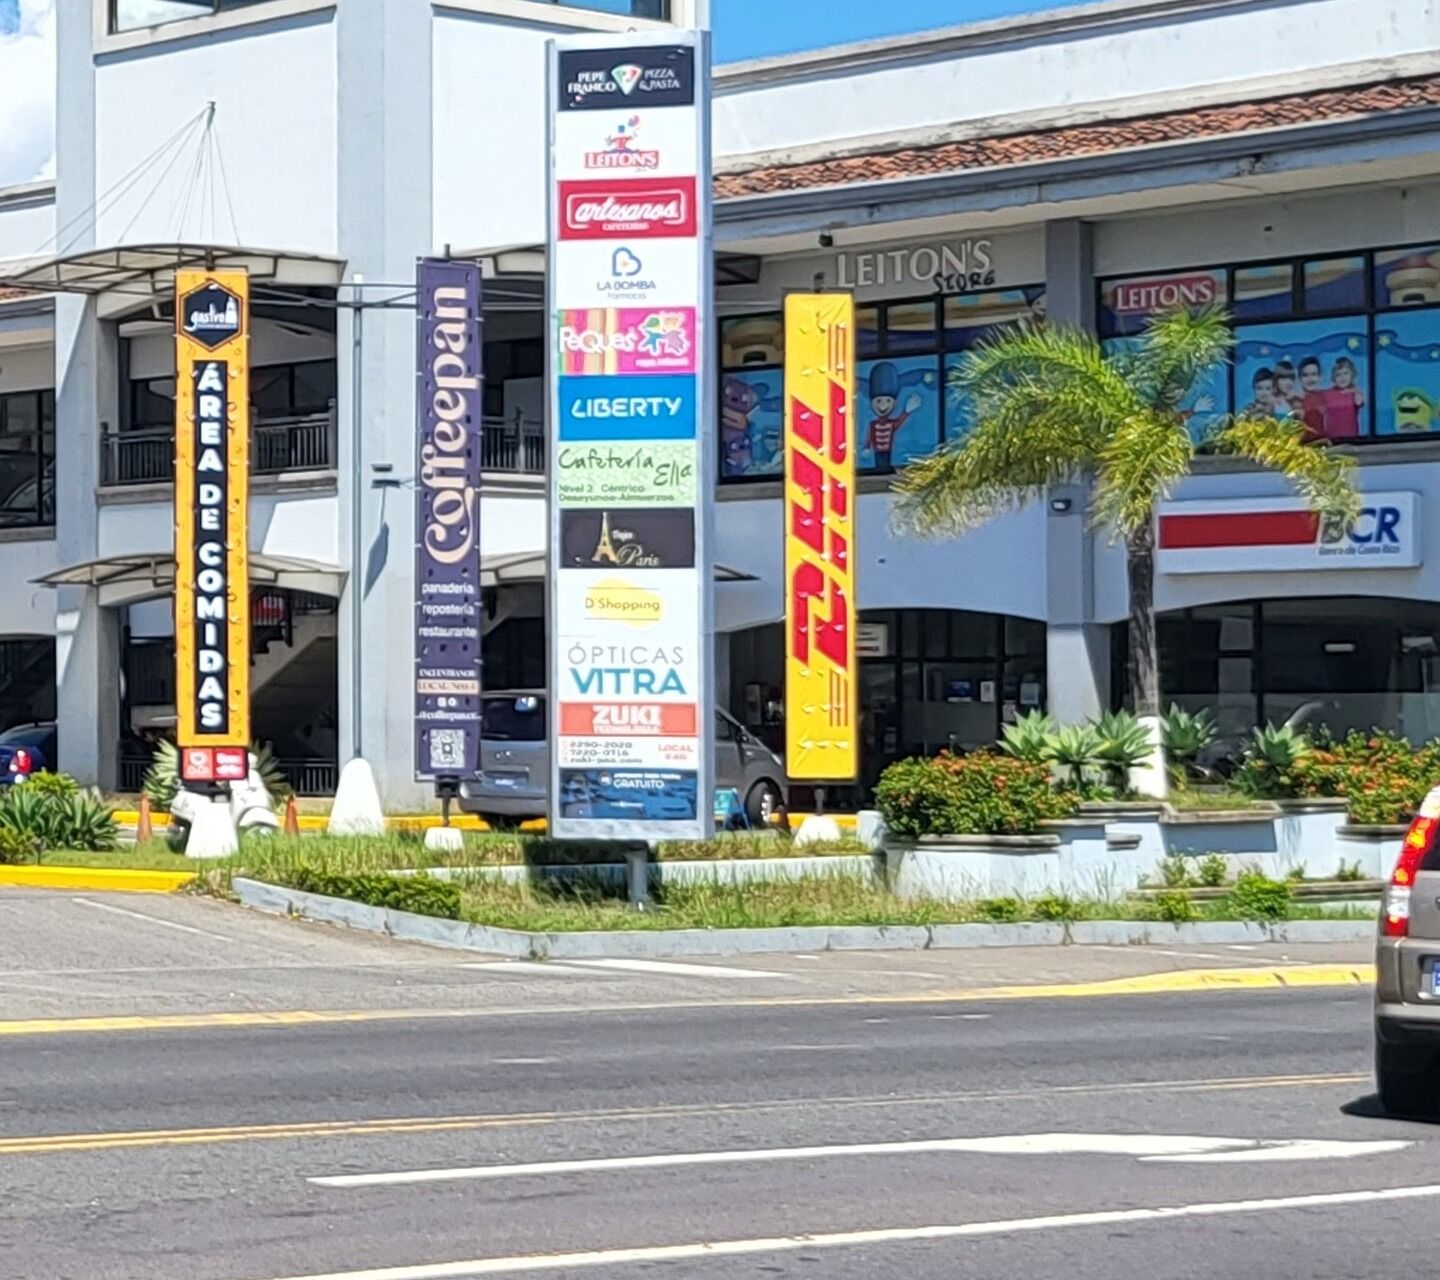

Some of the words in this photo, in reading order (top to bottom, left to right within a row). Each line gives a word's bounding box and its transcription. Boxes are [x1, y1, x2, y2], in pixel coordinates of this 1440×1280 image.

[578, 72, 605, 82] PEPE
[644, 69, 675, 79] PIZZA
[650, 79, 680, 89] PASTA
[568, 82, 616, 94] FRANCO
[575, 197, 678, 221] artesanos
[836, 239, 992, 288] LEITON'S
[597, 281, 612, 290] LA
[614, 280, 656, 290] BOMBA
[933, 270, 995, 294] STORE
[571, 397, 682, 418] LIBERTY
[422, 287, 478, 564] Coffeepan
[559, 448, 653, 470] Cafetería
[654, 460, 692, 486] Ella
[587, 484, 593, 492] 2
[199, 483, 222, 530] DE
[792, 378, 848, 672] DHL
[1321, 507, 1400, 544] BCR
[616, 544, 660, 566] Paris
[197, 542, 224, 727] COMIDAS
[419, 626, 477, 637] restaurante
[568, 641, 683, 665] ÓPTICAS
[569, 668, 687, 695] VITRA
[592, 704, 661, 725] ZUKI
